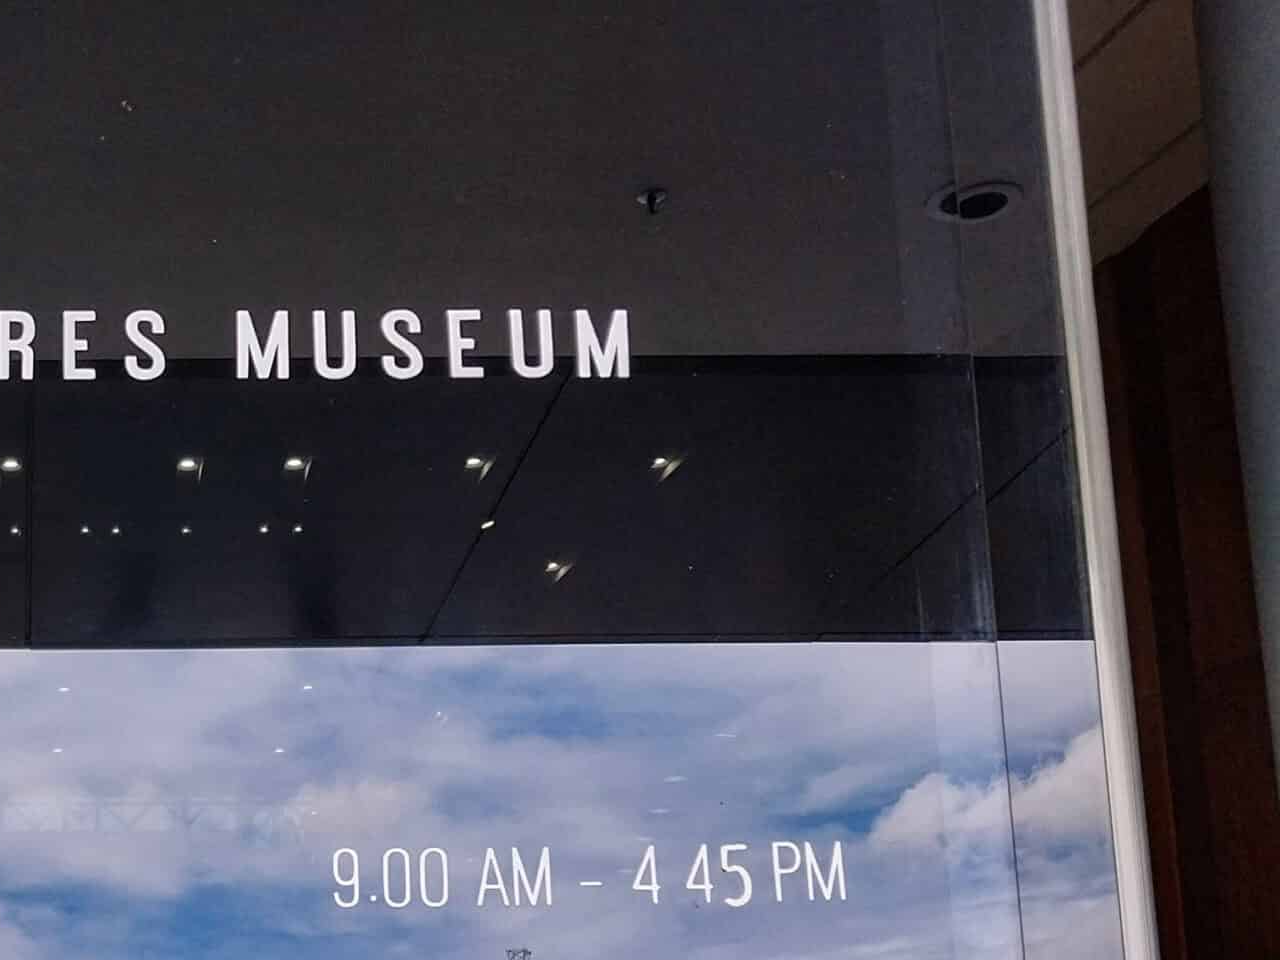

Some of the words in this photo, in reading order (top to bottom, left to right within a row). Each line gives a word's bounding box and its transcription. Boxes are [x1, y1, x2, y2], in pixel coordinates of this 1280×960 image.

[236, 309, 631, 380] MUSEUM
[333, 847, 449, 908] 9.00
[476, 846, 553, 907] AM
[771, 840, 848, 903] PM
